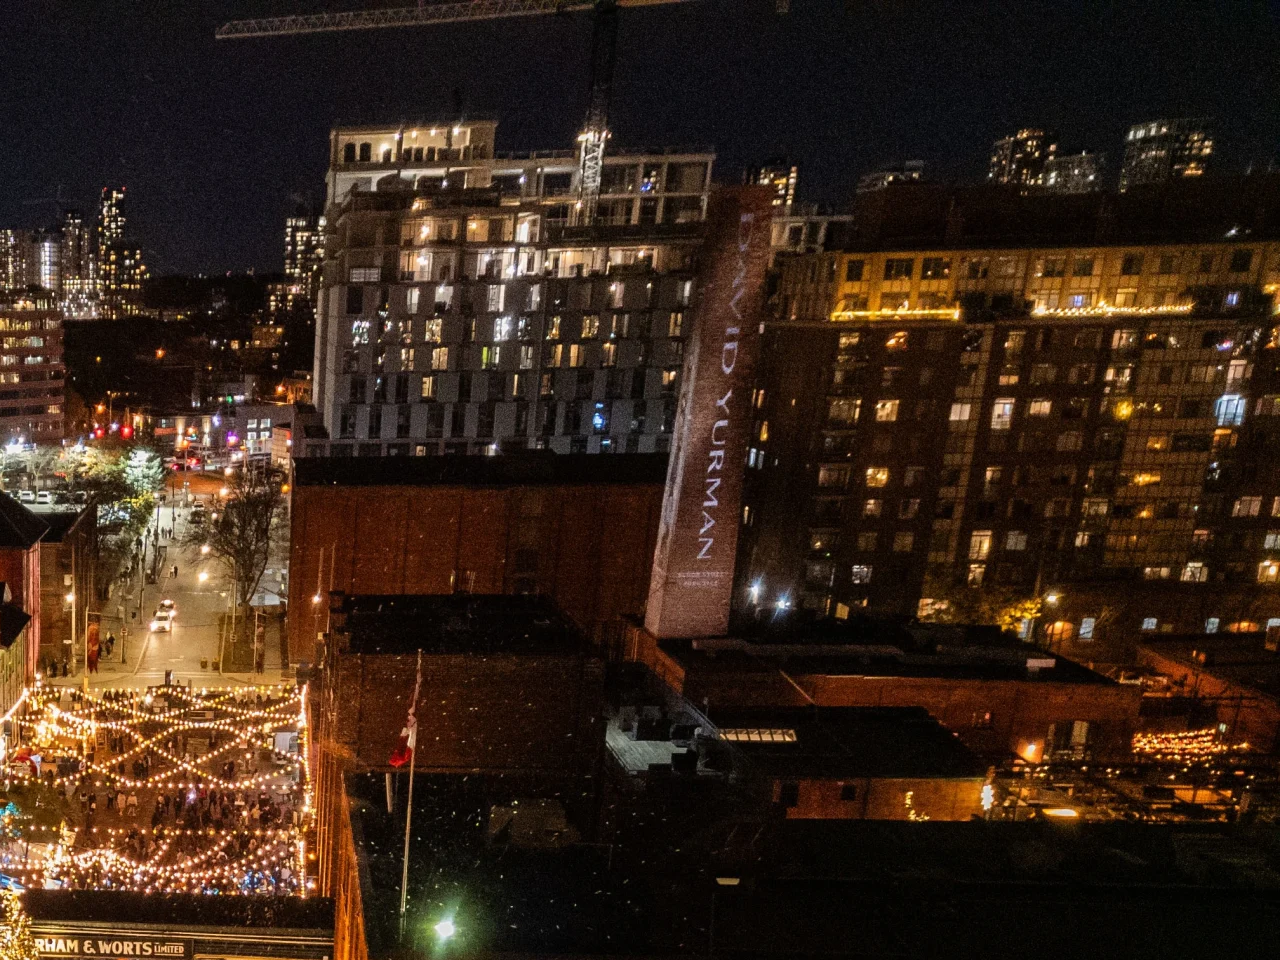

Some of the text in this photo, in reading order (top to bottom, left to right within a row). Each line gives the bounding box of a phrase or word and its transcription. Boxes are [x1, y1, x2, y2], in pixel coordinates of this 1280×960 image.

[722, 213, 754, 374] DAVID
[697, 388, 733, 560] YURMAN
[83, 940, 96, 954] &
[98, 940, 152, 955] WORTS
[154, 945, 185, 954] LIMITED
